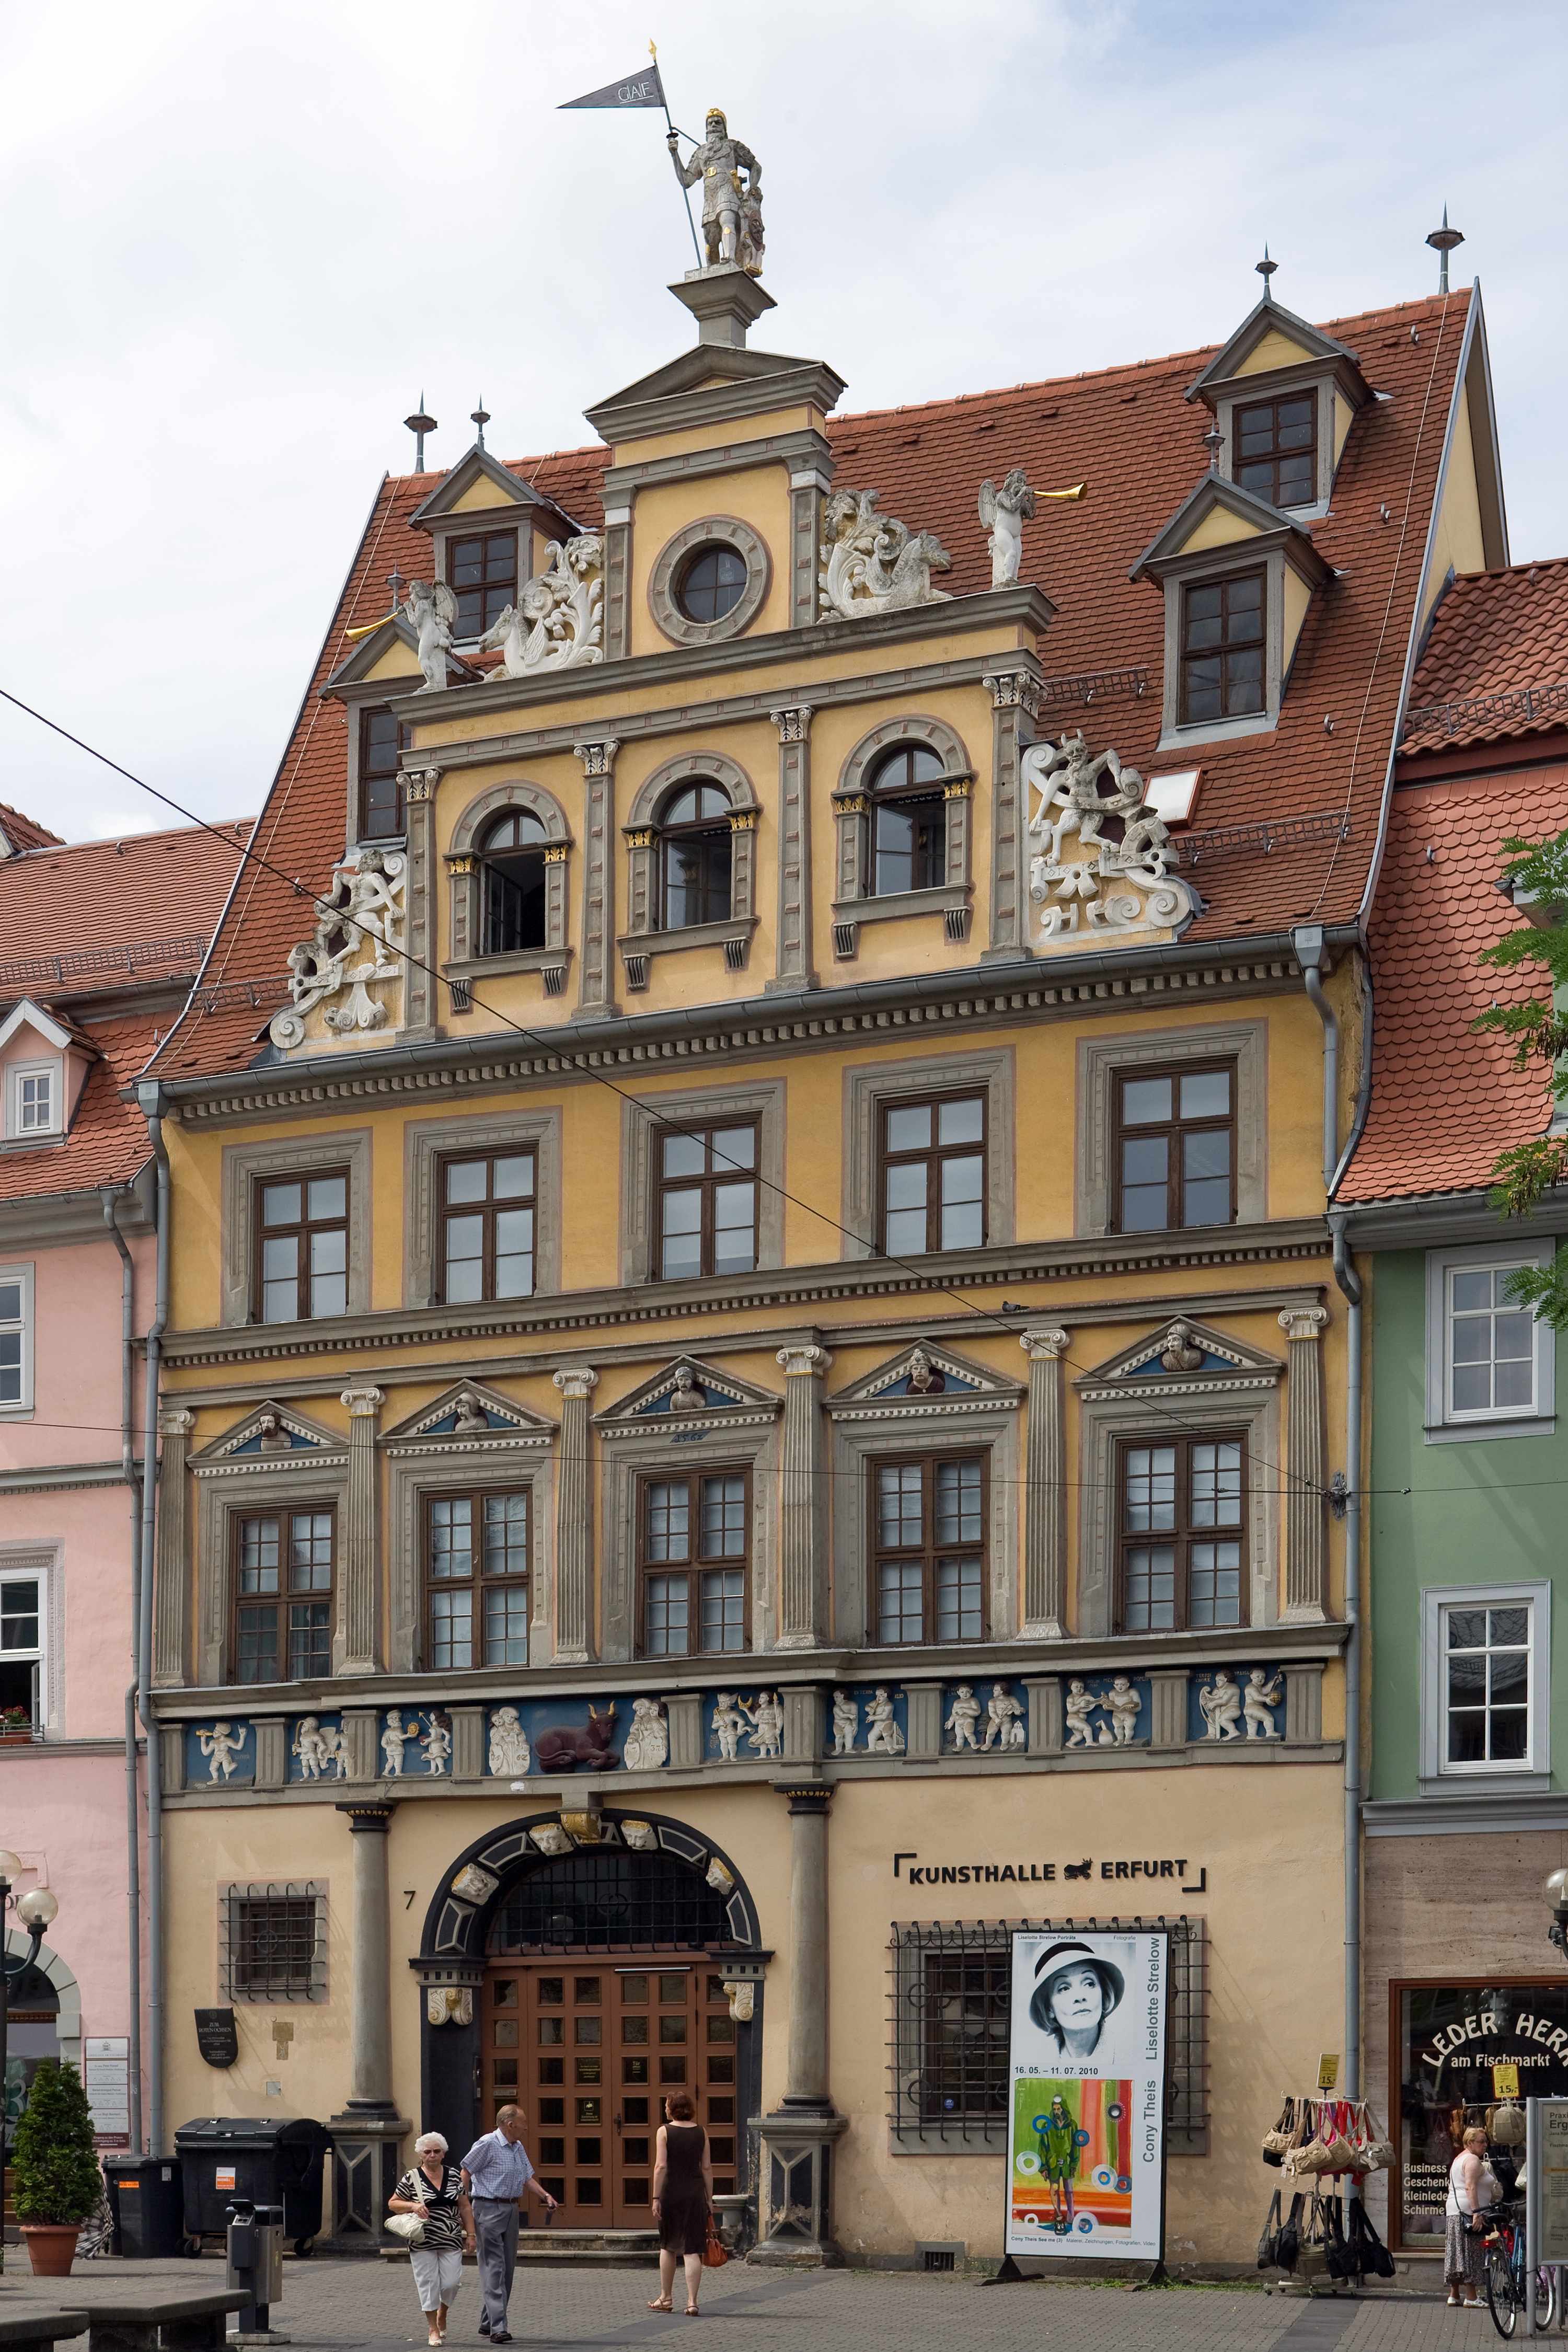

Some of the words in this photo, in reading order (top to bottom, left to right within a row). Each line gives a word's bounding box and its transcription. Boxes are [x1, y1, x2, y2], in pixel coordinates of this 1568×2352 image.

[909, 1863, 1056, 1884] KUNSTHALLE
[1101, 1859, 1187, 1878] ERFURT
[403, 1890, 416, 1910] 7
[1147, 1937, 1160, 1993] Strelow
[1145, 1997, 1159, 2060] Liselotte
[1422, 2012, 1498, 2067] LEDER
[1451, 2057, 1471, 2067] am
[1475, 2053, 1550, 2067] Fischmarkt
[1144, 2080, 1156, 2120] Theis
[1143, 2124, 1158, 2162] Cony
[1404, 2163, 1447, 2173] Business
[1403, 2176, 1450, 2187] Geschenk
[1404, 2190, 1448, 2201] Kleinlede
[1403, 2205, 1445, 2215] Schirme
